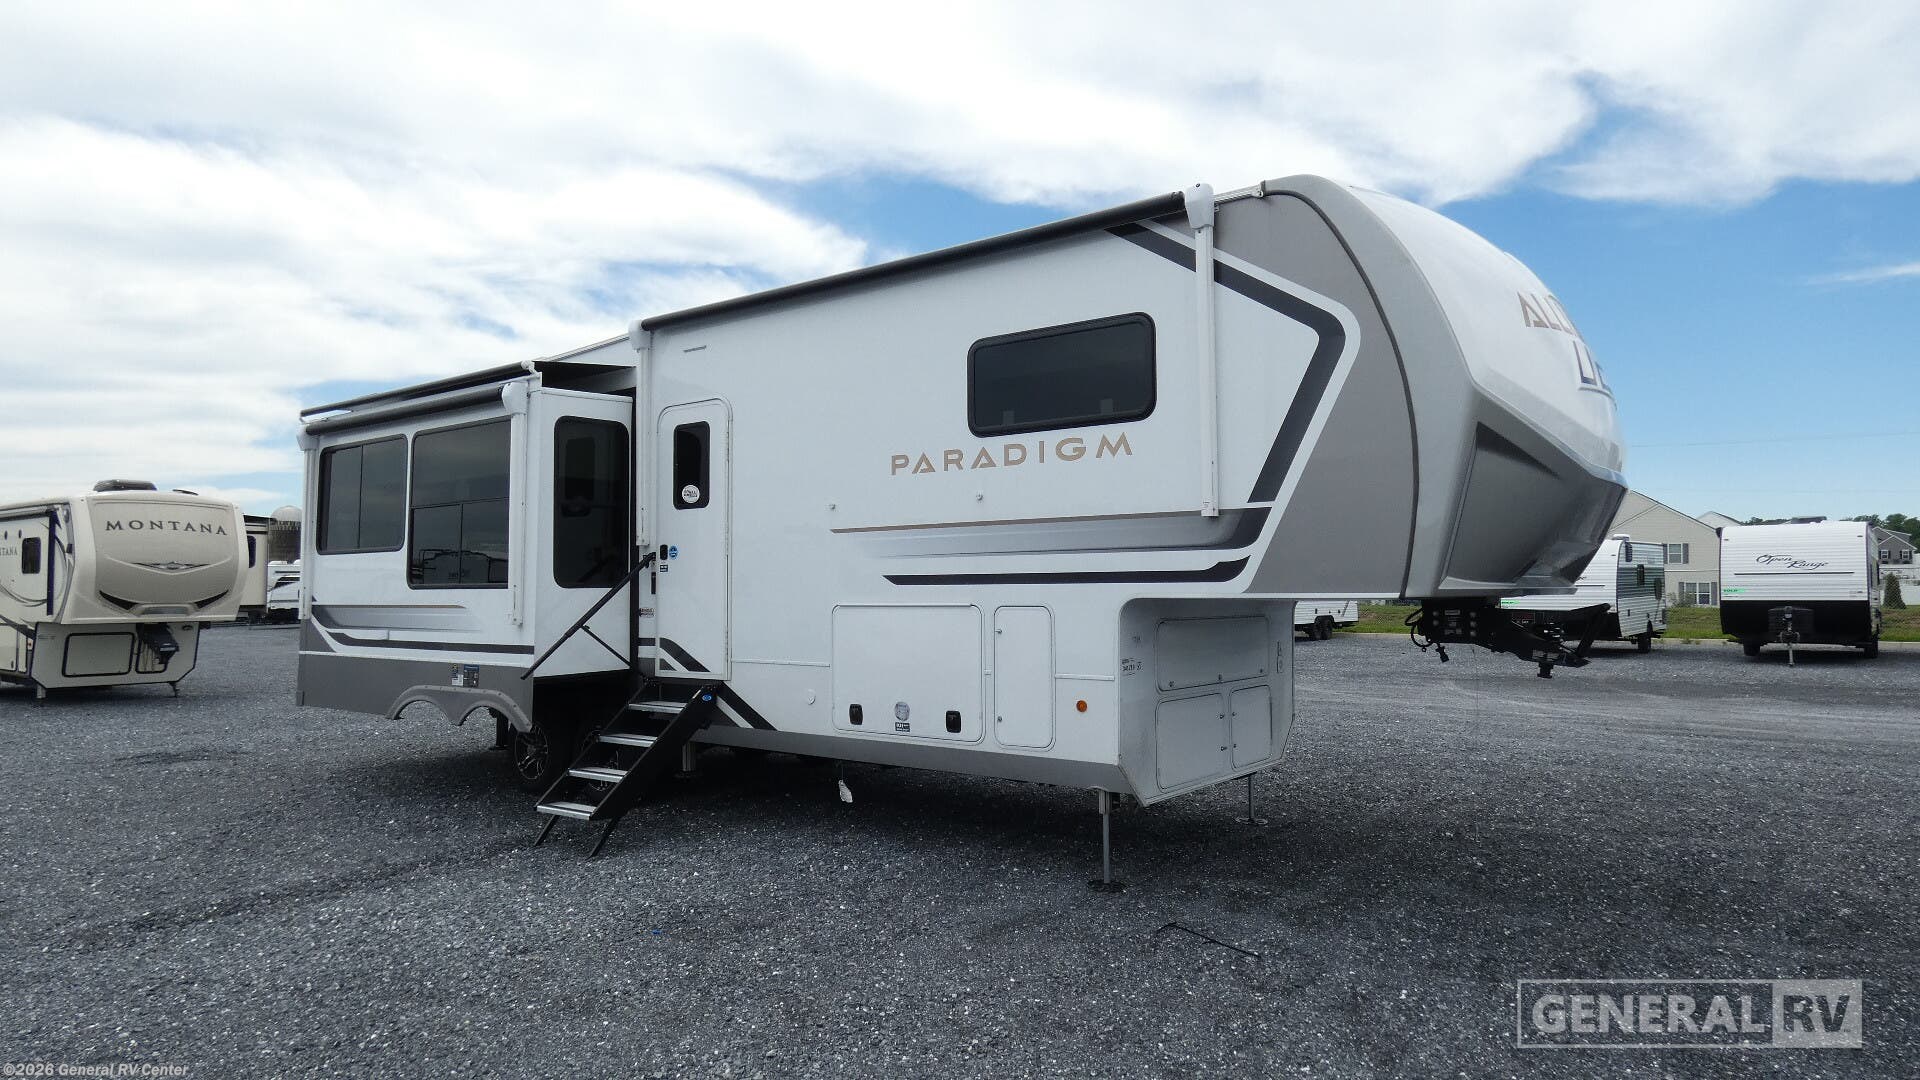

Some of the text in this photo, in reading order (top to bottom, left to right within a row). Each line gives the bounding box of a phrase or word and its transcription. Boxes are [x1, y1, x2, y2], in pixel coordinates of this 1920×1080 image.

[890, 431, 1133, 476] PARADIGM
[106, 519, 227, 536] MONTANA
[1756, 554, 1829, 571] Open Range
